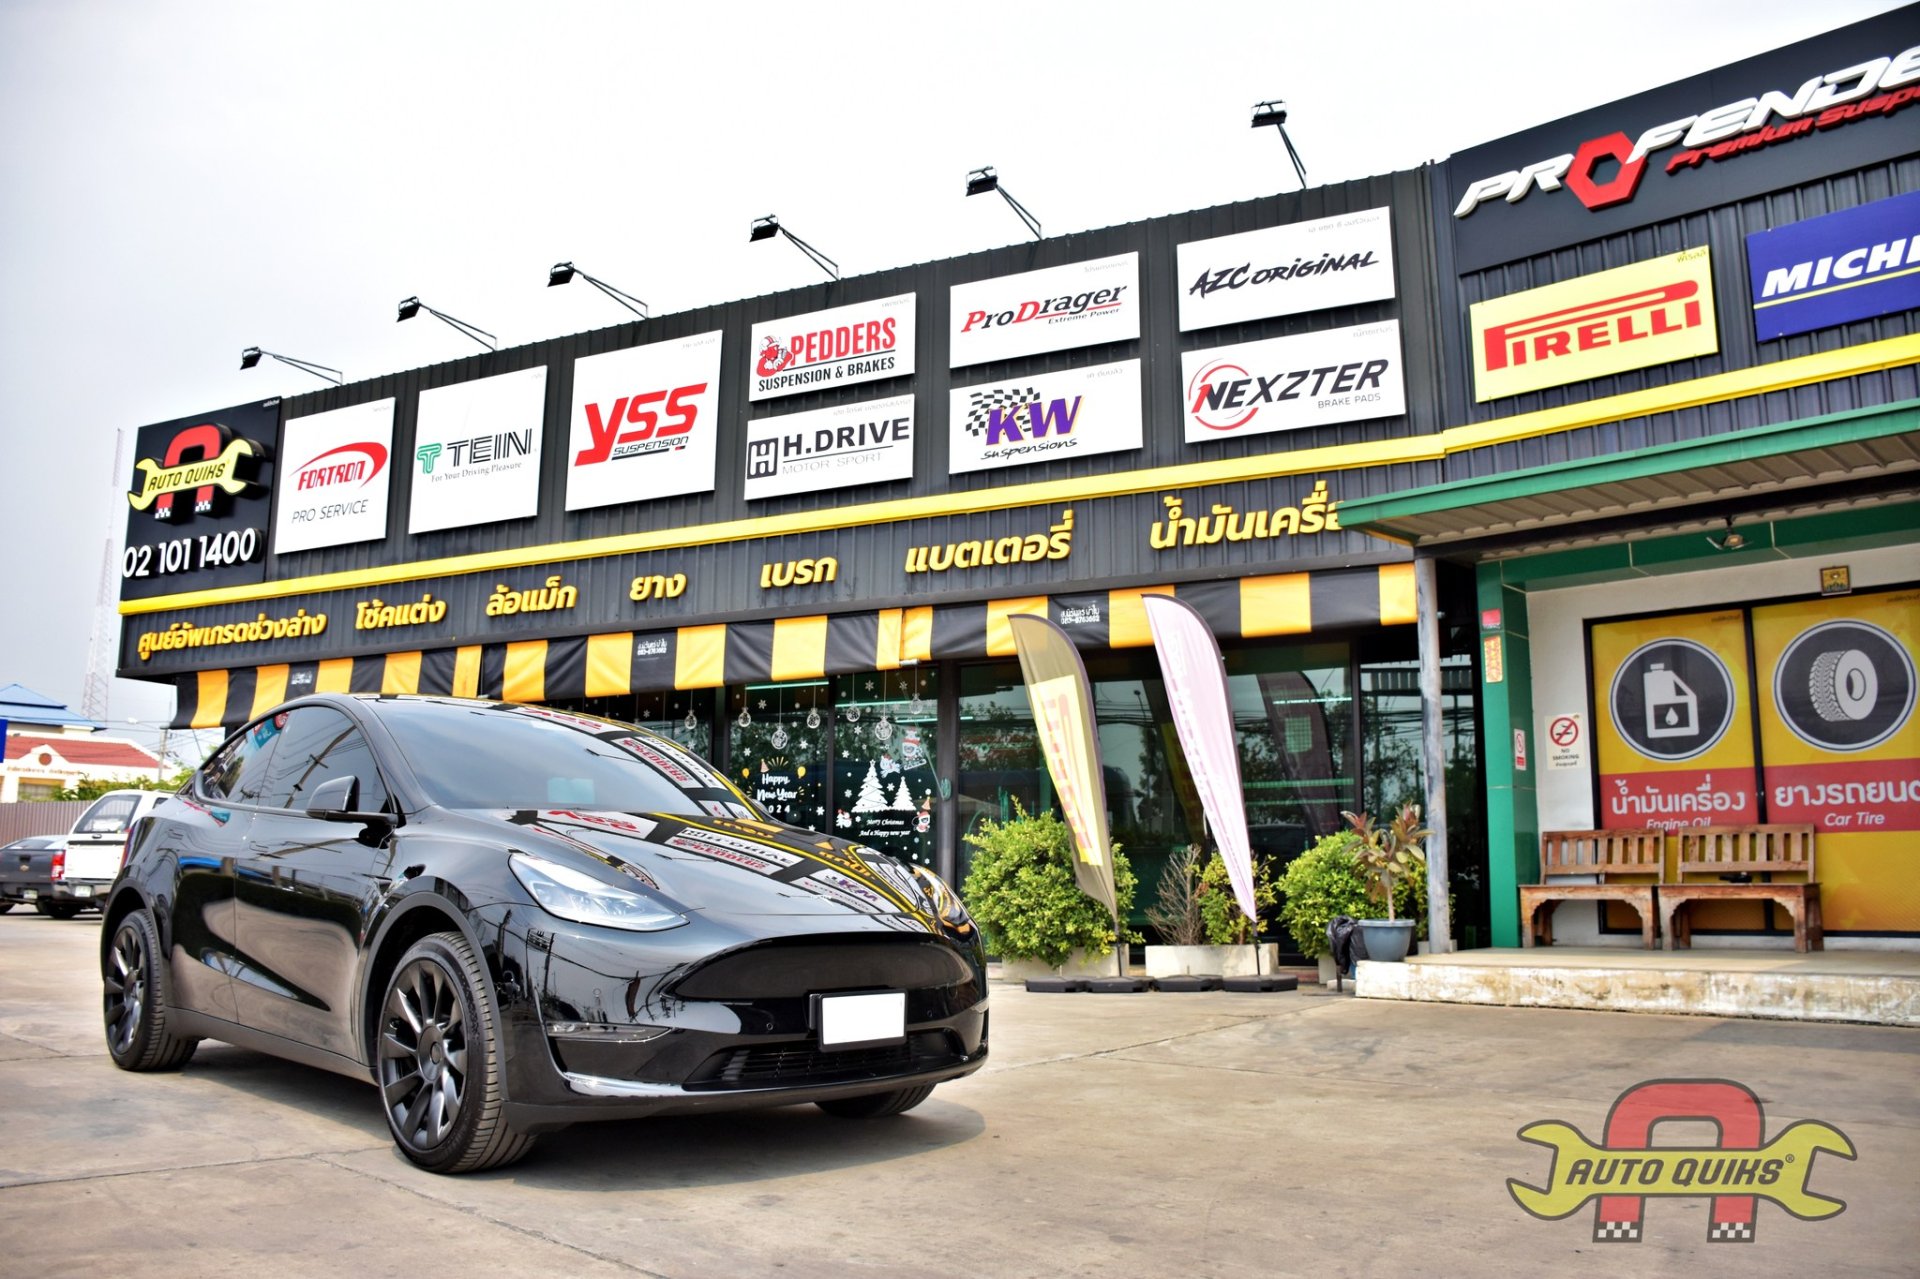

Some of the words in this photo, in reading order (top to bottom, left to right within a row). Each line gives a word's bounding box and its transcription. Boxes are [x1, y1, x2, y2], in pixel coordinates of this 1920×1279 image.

[1189, 263, 1250, 299] AZC
[961, 286, 1127, 332] ProDrager
[1048, 313, 1087, 325] Extreme
[1090, 308, 1120, 317] Power
[1483, 280, 1702, 371] PIRELLI
[790, 317, 896, 366] PEDDERS
[758, 367, 831, 392] SUSPENSION
[835, 366, 844, 379] &
[847, 357, 895, 377] BRAKES
[1191, 359, 1389, 413] NEXZTER
[1318, 396, 1351, 409] BRAKE
[1354, 393, 1381, 403] PADS
[783, 417, 910, 457] H.DRIVE
[986, 395, 1083, 446] KW
[447, 428, 532, 467] TEIN
[613, 436, 689, 456] SUSPENSION
[782, 460, 829, 475] MOTOR
[837, 452, 882, 467] SPORT
[147, 472, 182, 491] AUTO
[298, 459, 366, 491] FORTRON
[431, 475, 442, 483] For
[445, 472, 460, 481] Your
[462, 466, 490, 478] Driving
[491, 462, 522, 472] Pleasure
[292, 508, 316, 524] PRO
[320, 499, 368, 520] SERVICE
[122, 545, 152, 578] 02
[159, 538, 191, 574] 101
[199, 528, 256, 568] 1400
[137, 608, 327, 661] ศูนย์อัพเกรดช่วงล่าง
[355, 594, 447, 630] โช้คแต่ง
[485, 575, 578, 617] ล้อแม็ก
[629, 573, 687, 601] ยาง
[760, 556, 838, 588] เบรก
[904, 509, 1074, 574] แบตเตอรี่
[757, 788, 776, 801] New
[777, 788, 798, 801] Year
[761, 774, 791, 786] Happy
[1612, 774, 1745, 814] น้ำมันเครื่อง
[1824, 813, 1852, 826] Car
[1856, 812, 1885, 825] Tire
